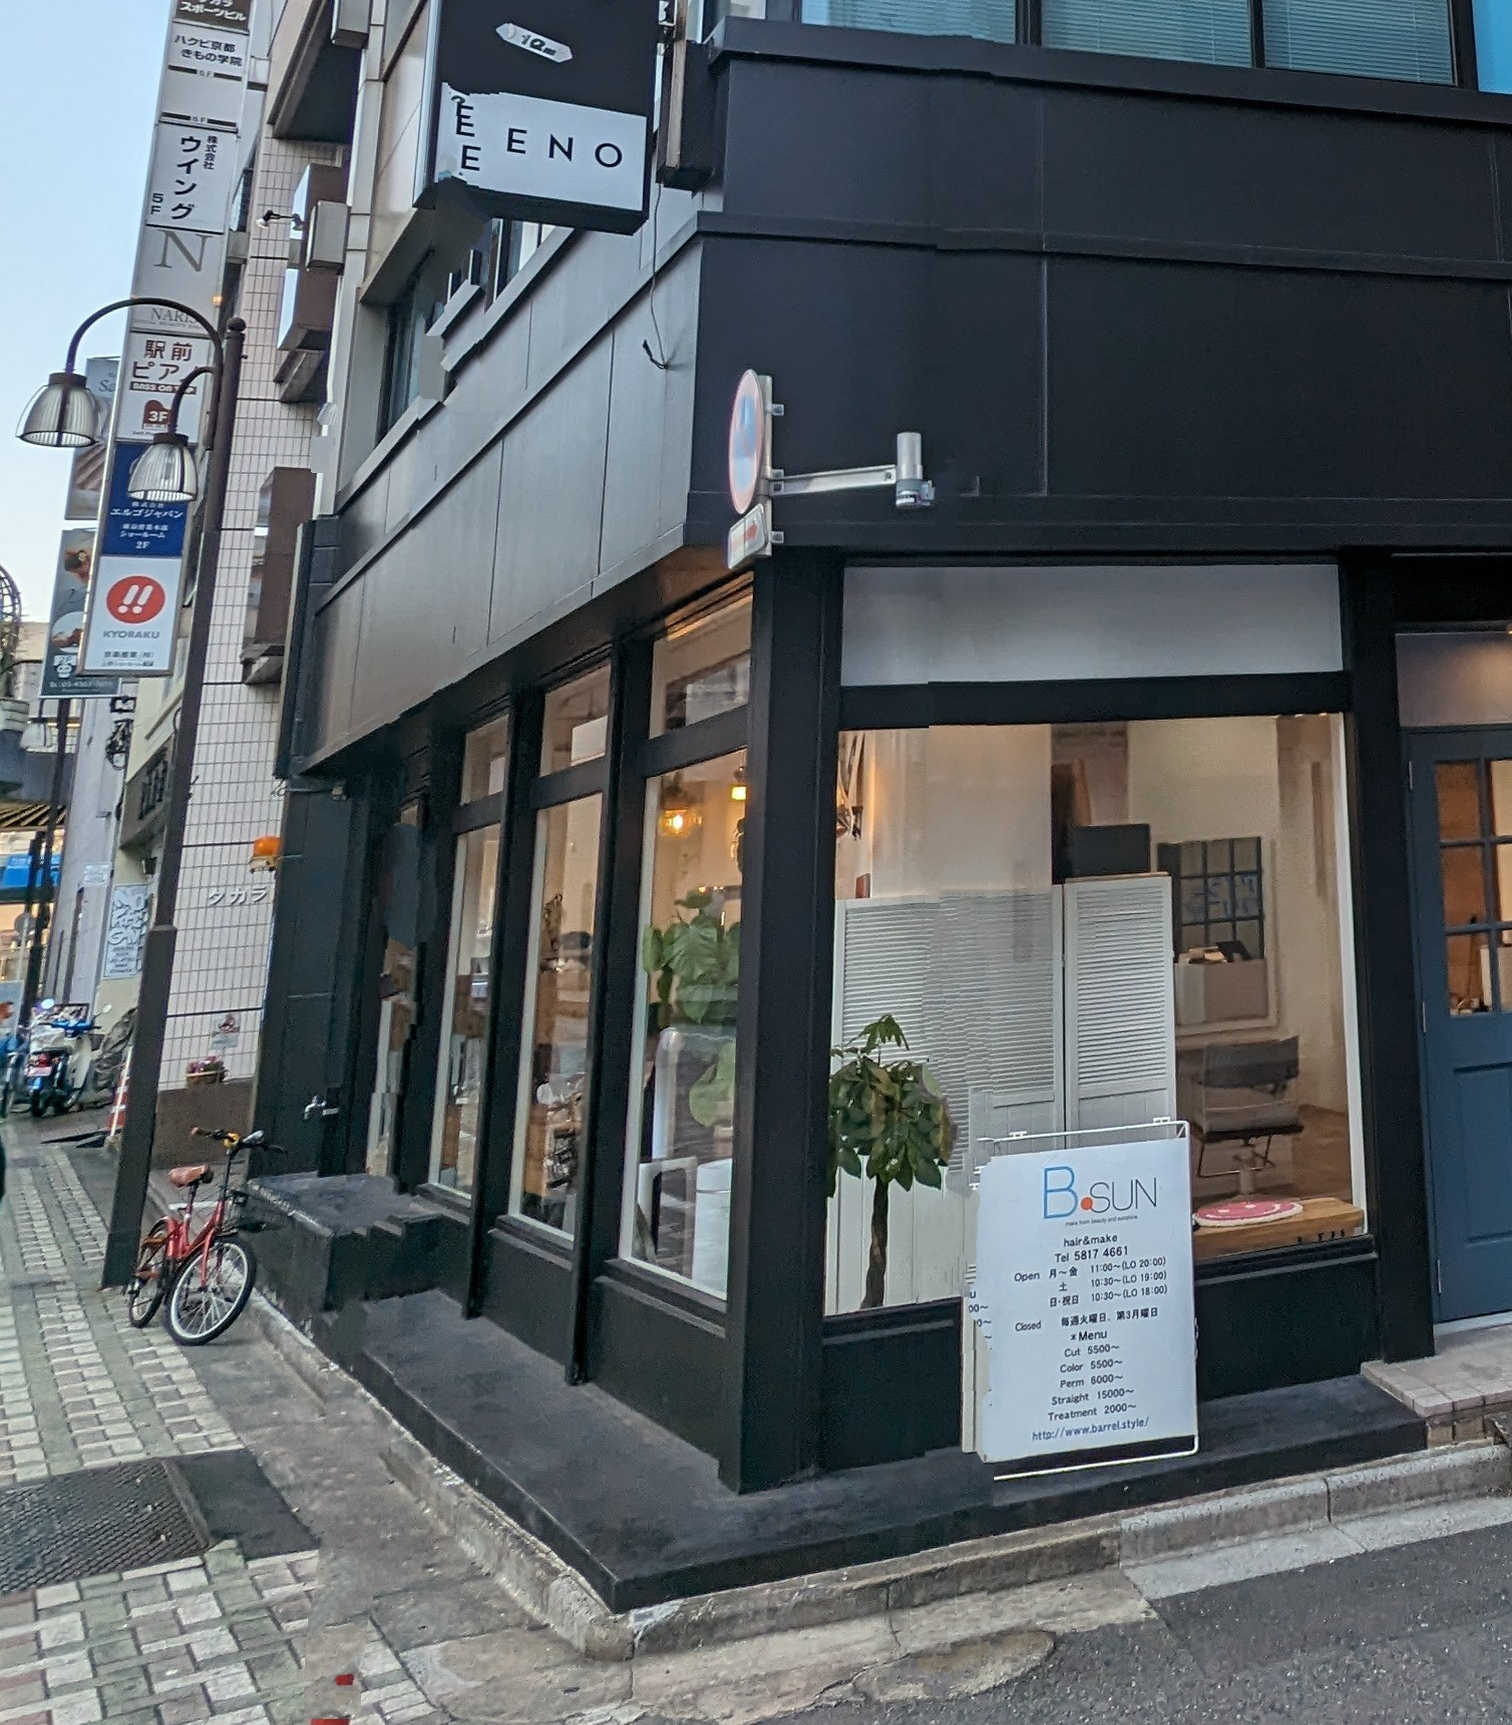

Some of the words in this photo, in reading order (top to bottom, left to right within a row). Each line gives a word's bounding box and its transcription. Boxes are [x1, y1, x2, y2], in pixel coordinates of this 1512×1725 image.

[180, 1, 246, 21] スポーツビル
[174, 34, 236, 53] ハクビ京都
[181, 48, 242, 67] きもの学院
[203, 135, 218, 171] 株式会社
[171, 136, 201, 220] ウイング
[151, 192, 164, 216] 5F
[153, 229, 213, 272] N
[144, 339, 193, 361] 駅前
[132, 361, 198, 382] ピア
[149, 410, 168, 422] 3F
[110, 508, 183, 518] エルゴジャパン
[135, 540, 150, 549] 2F
[103, 630, 160, 639] KYORAKU
[208, 886, 268, 906] タカラ
[1063, 1234, 1118, 1247] hair&make
[1055, 1253, 1070, 1263] Tel
[1074, 1249, 1099, 1262] 5817
[1014, 1272, 1040, 1282] Open
[1059, 1281, 1068, 1292] 土
[1015, 1321, 1041, 1332] Closed
[1064, 1347, 1081, 1357] Cut
[1060, 1363, 1084, 1373] Color
[1060, 1378, 1084, 1388] Perm
[1051, 1392, 1089, 1406] Straight
[1048, 1408, 1097, 1422] Treatment
